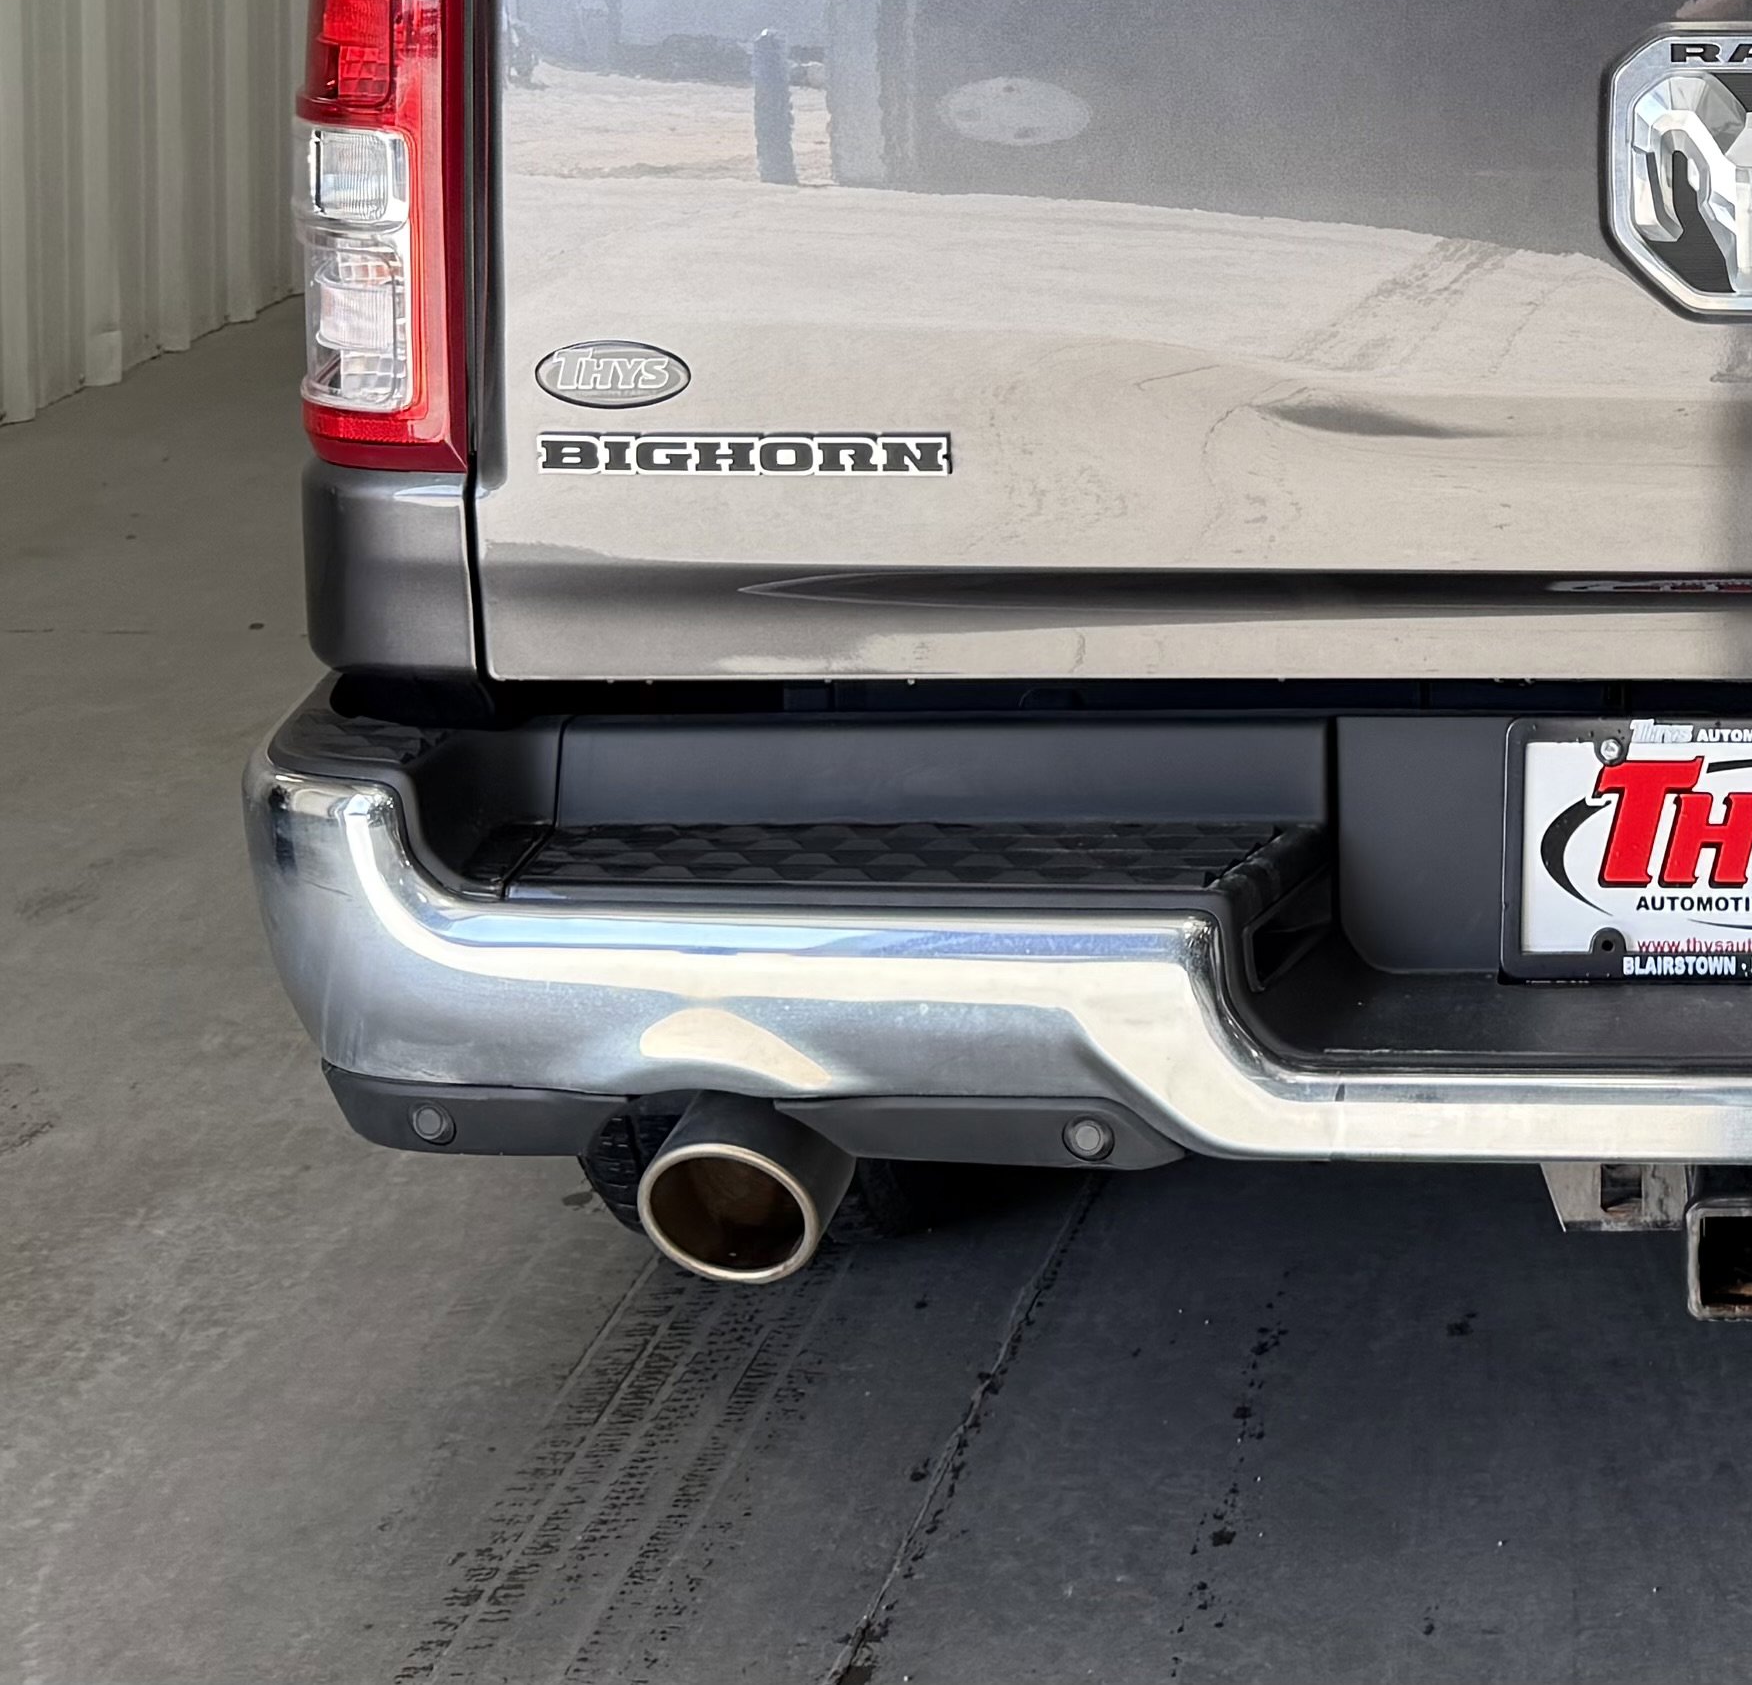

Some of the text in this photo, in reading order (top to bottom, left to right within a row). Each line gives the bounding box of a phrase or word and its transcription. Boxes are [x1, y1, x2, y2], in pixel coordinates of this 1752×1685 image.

[553, 347, 670, 390] THYS
[538, 435, 949, 476] BIGHORN
[1622, 956, 1737, 976] BLAIRSTOWN
